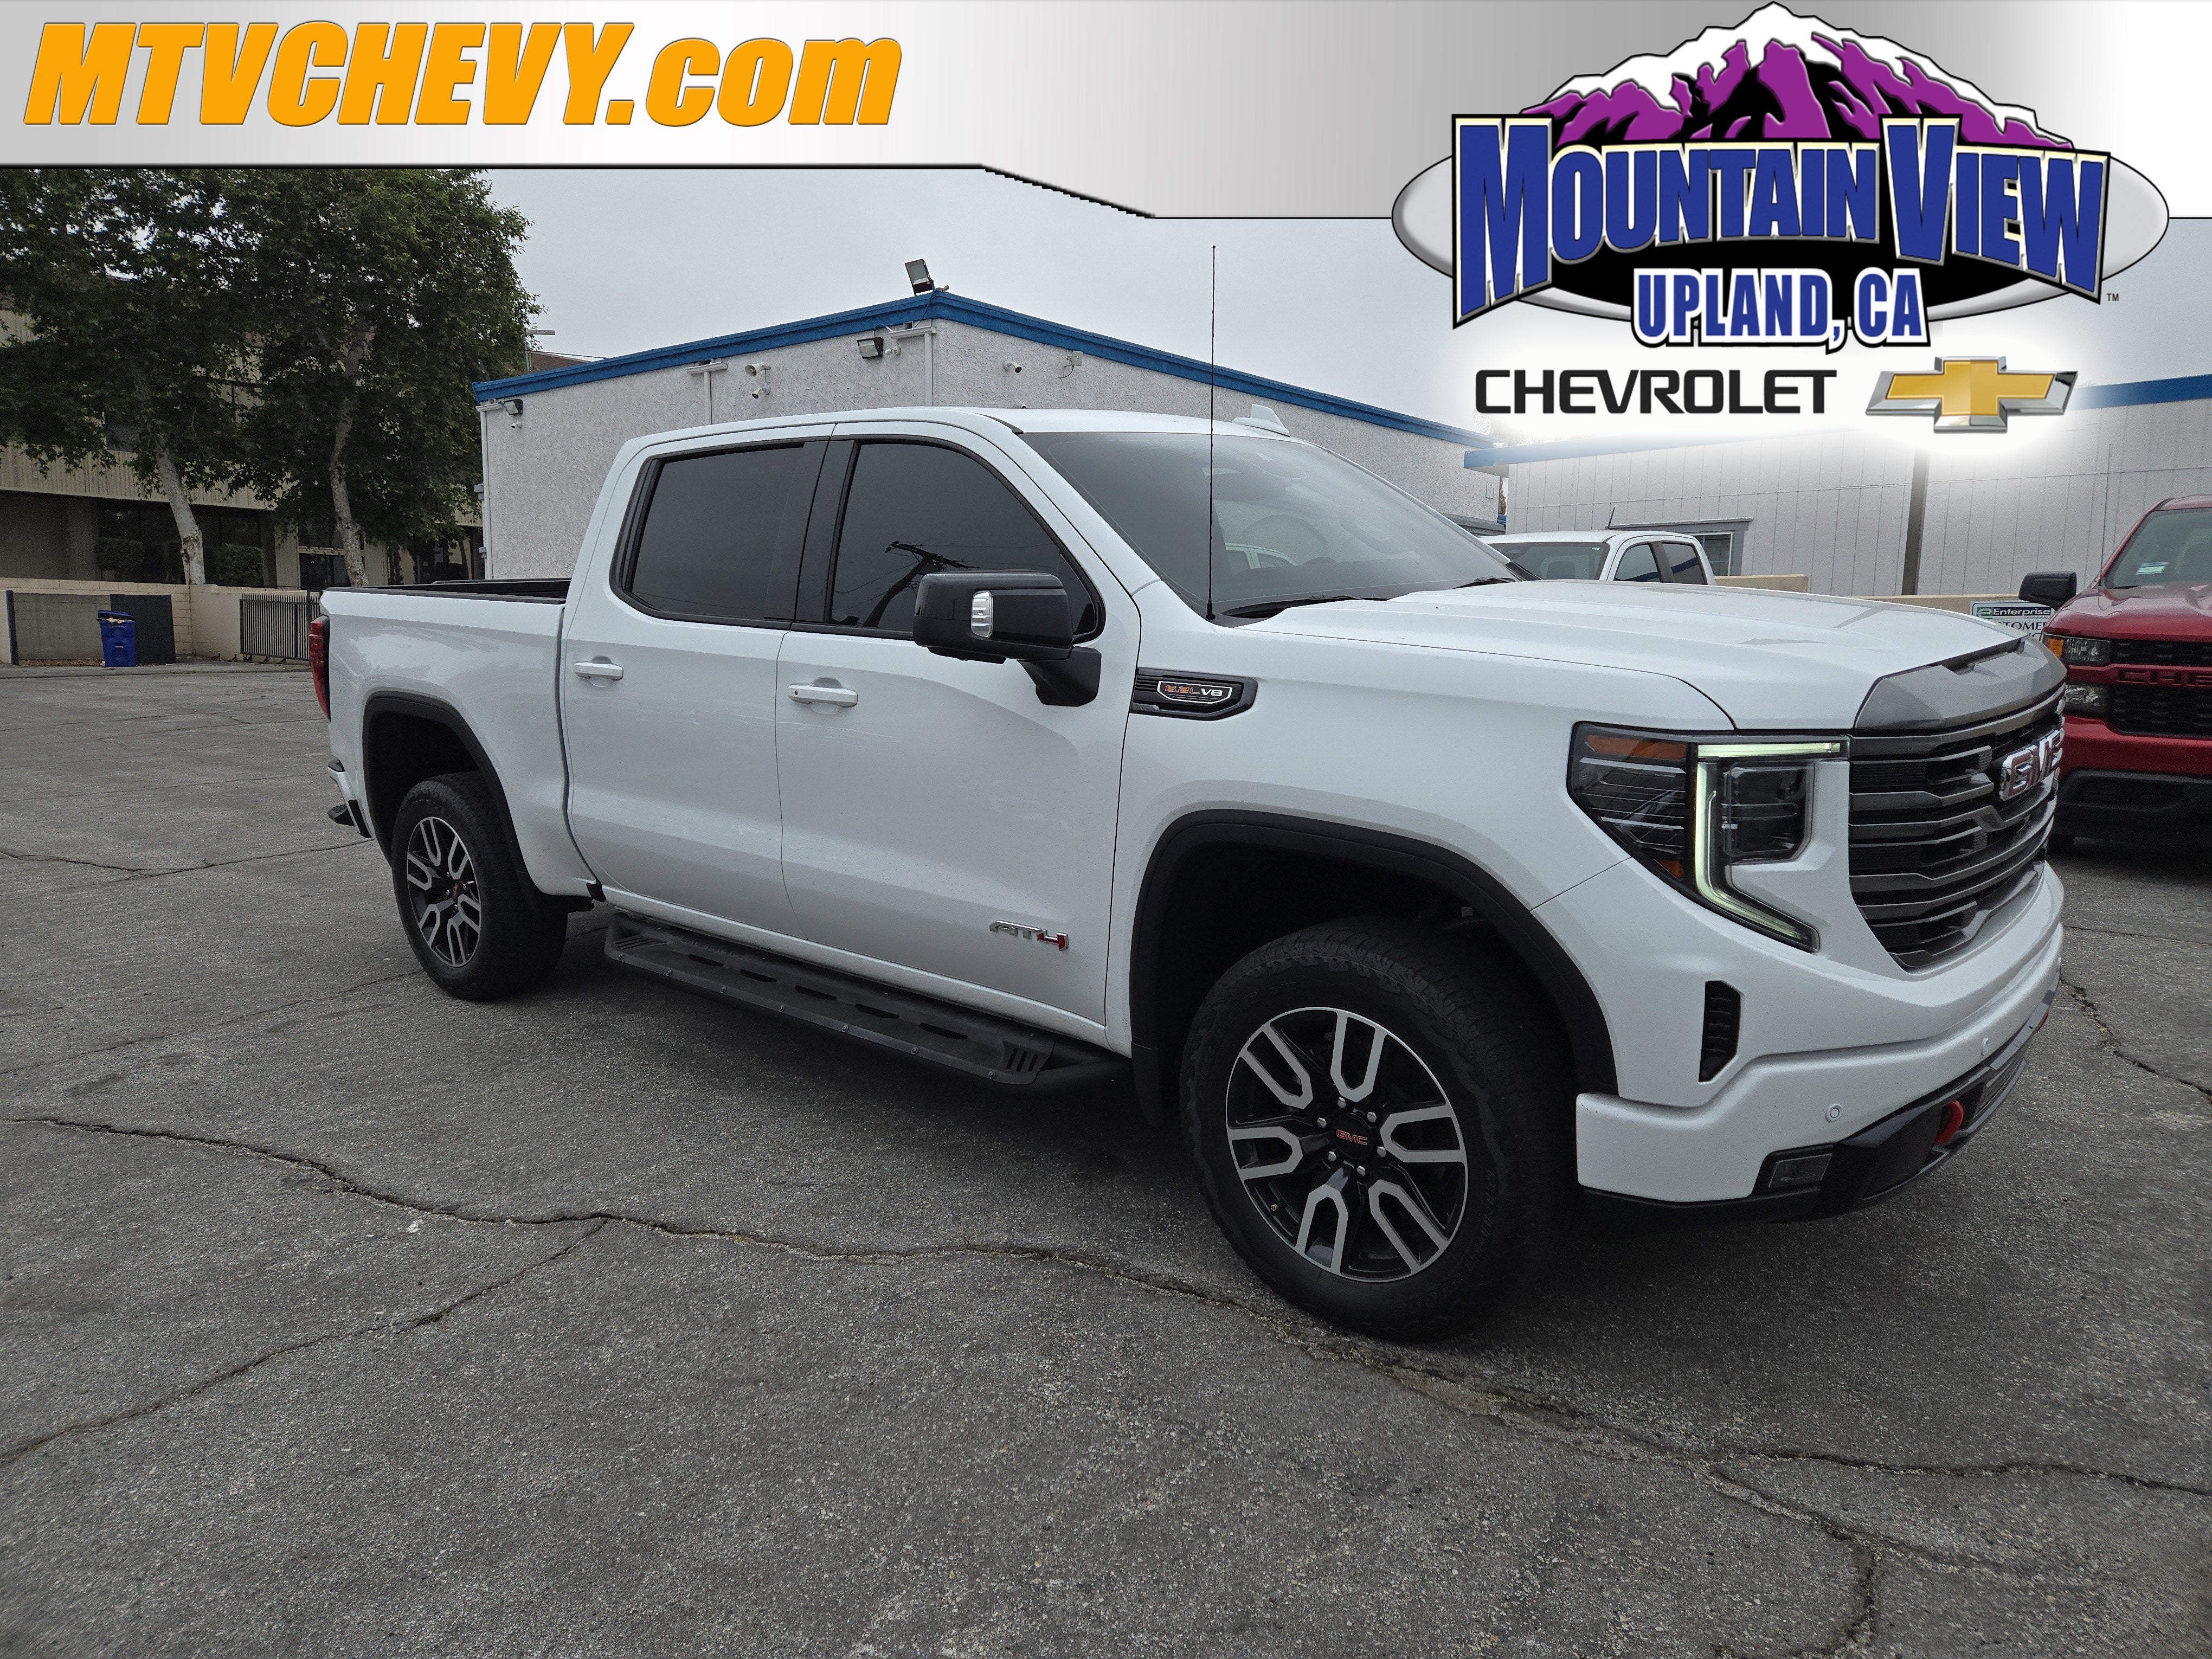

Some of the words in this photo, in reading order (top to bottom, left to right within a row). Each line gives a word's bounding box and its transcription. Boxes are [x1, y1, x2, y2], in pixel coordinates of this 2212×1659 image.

[1994, 608, 2051, 617] Enterprise
[989, 919, 1070, 951] AT4
[1336, 1128, 1368, 1146] GMC
